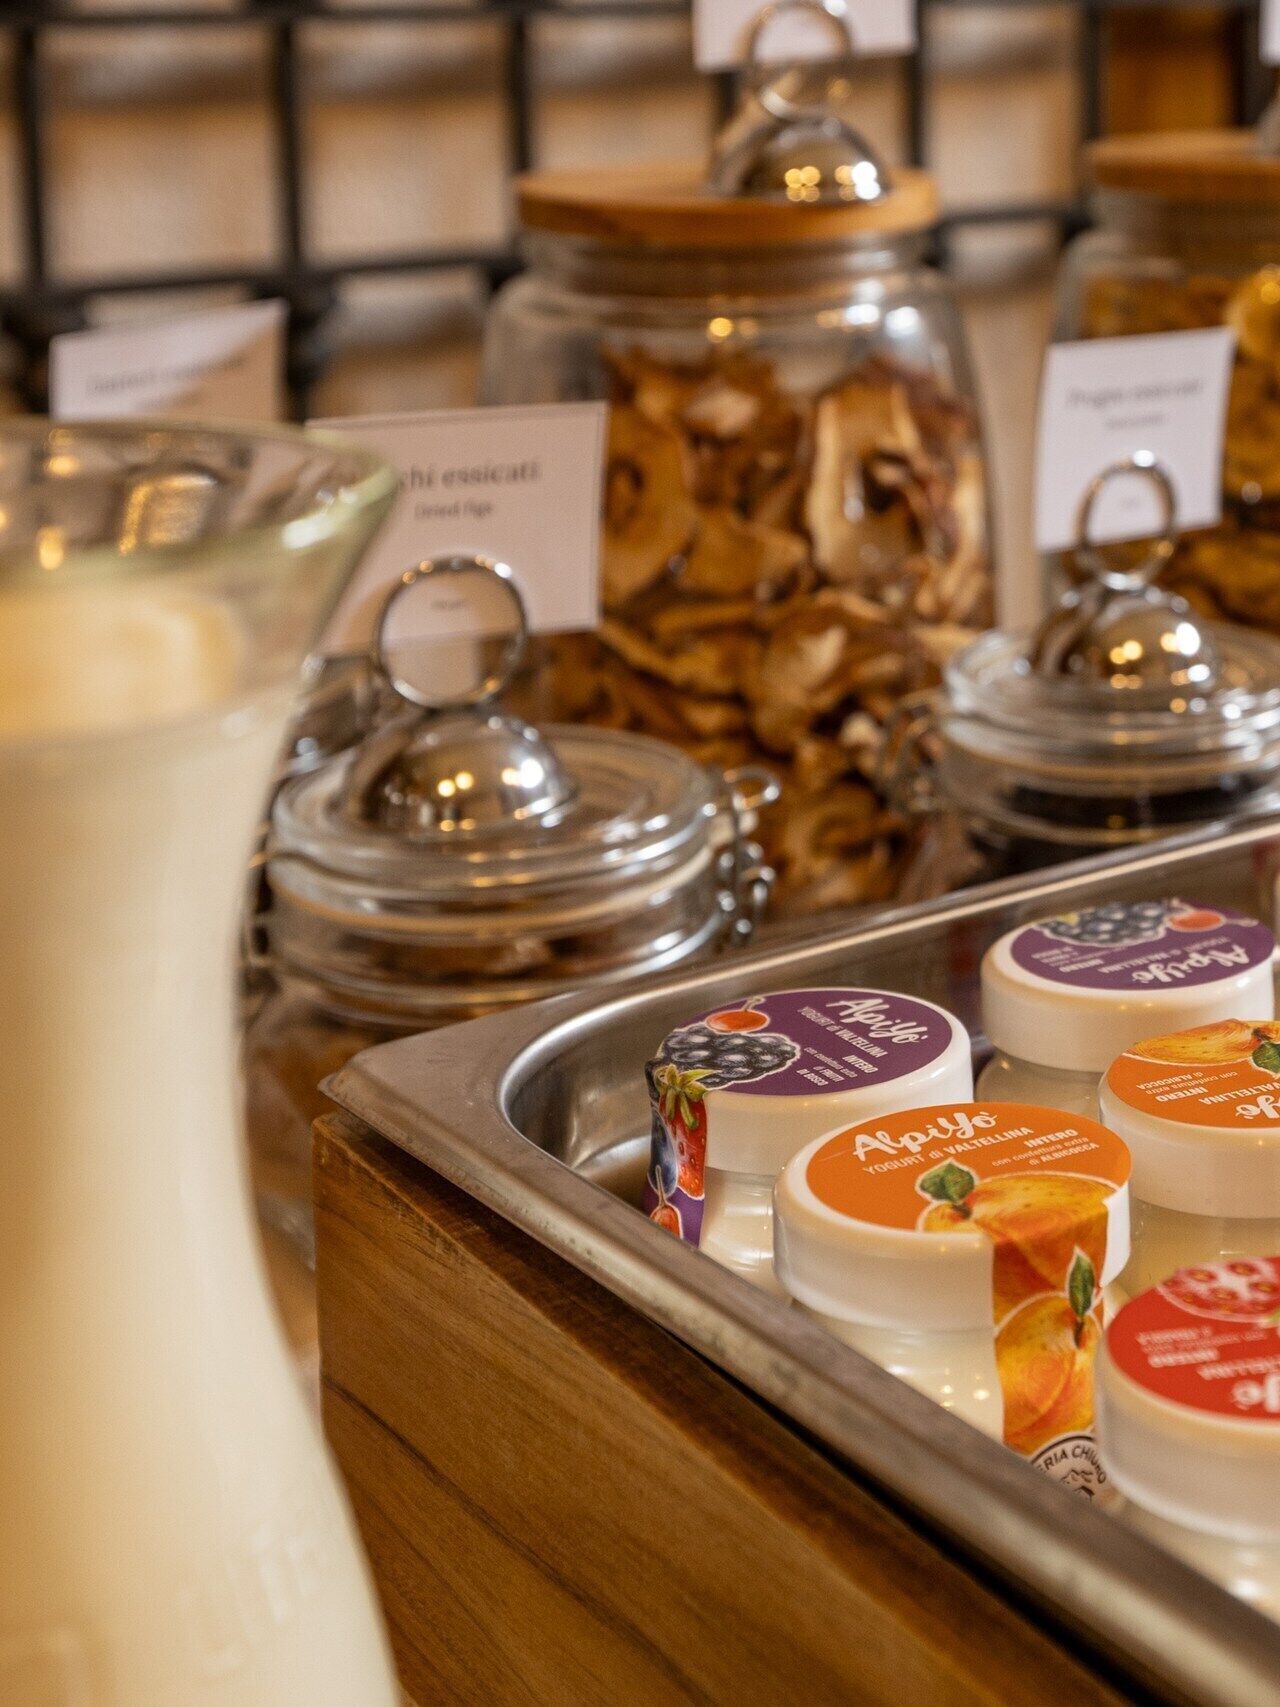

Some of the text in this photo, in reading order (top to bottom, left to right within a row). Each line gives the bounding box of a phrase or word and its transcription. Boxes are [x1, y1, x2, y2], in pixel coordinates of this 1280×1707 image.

[835, 1028, 888, 1058] VALTELLINA
[842, 1054, 879, 1074] INTERO
[1136, 1074, 1192, 1090] ALBICOCCA
[1171, 1074, 1219, 1089] confettura
[1219, 1070, 1238, 1079] con
[1155, 1086, 1209, 1102] INTERO
[1024, 1128, 1079, 1148] INTERO
[863, 1126, 1034, 1176] YOGURT di VALTELLINA
[1028, 1141, 1100, 1166] di ALBICOCCA
[991, 1157, 1011, 1167] con
